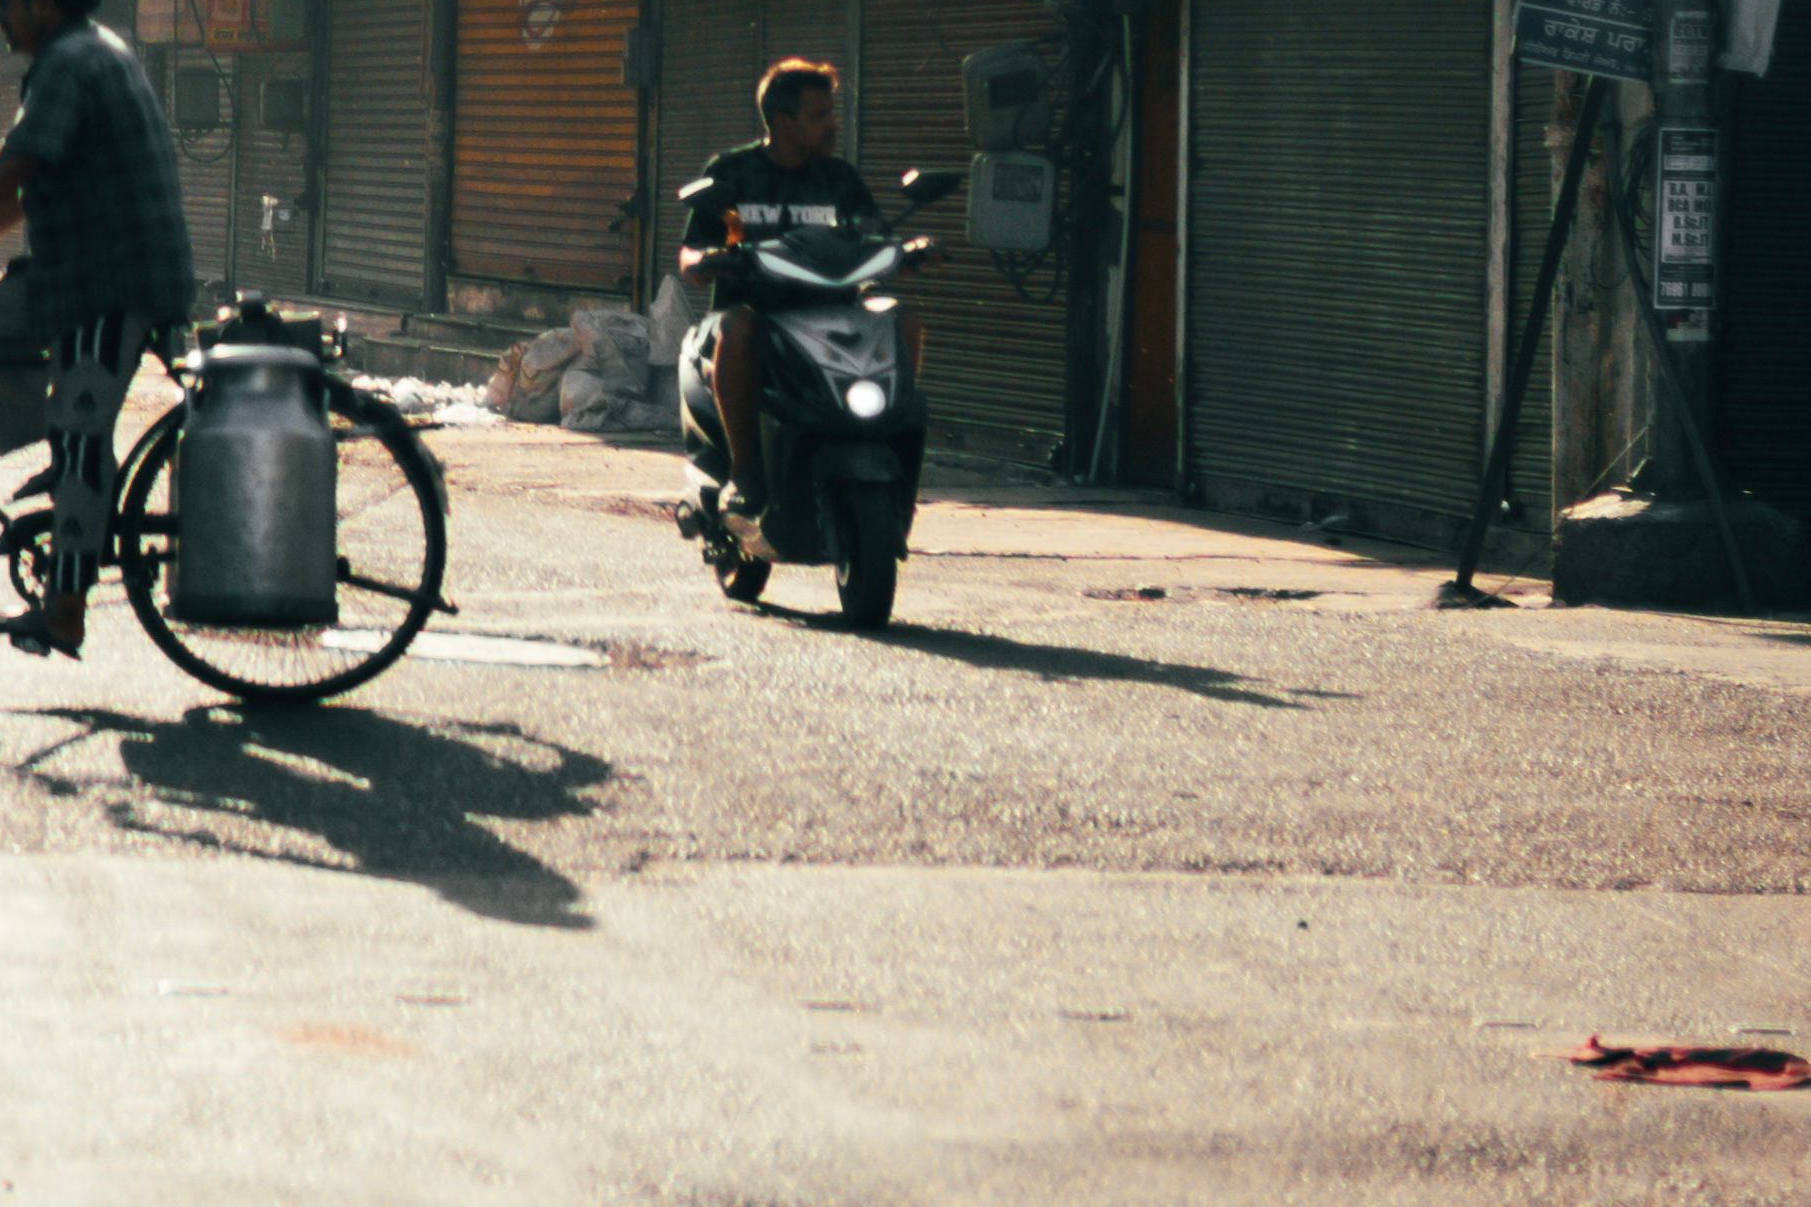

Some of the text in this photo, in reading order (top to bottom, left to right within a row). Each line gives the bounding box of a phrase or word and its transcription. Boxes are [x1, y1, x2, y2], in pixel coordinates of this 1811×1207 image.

[736, 203, 837, 225] NEW YORK
[1667, 199, 1690, 213] BCA
